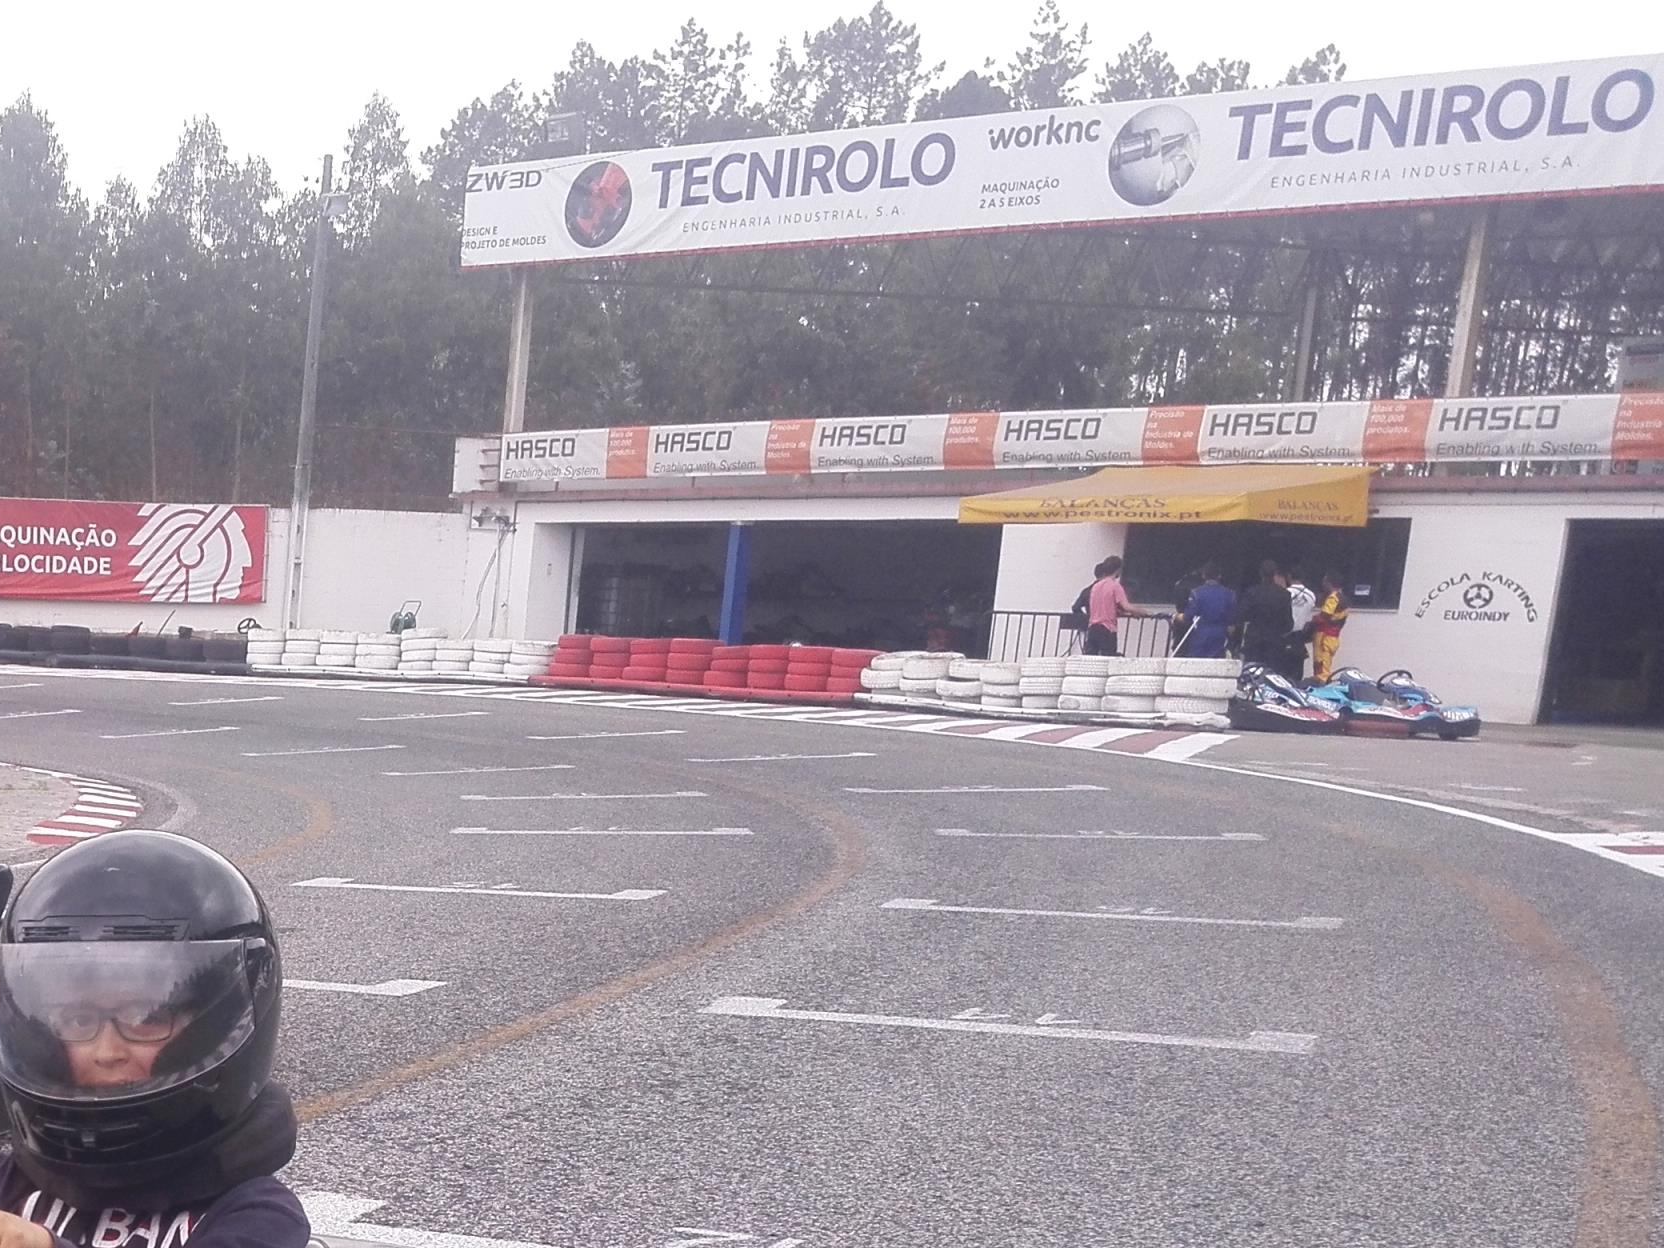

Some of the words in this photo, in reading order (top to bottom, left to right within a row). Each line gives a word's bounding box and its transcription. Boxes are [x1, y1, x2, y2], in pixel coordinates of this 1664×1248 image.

[1228, 68, 1655, 161] TECNIROLO
[988, 114, 1102, 151] worknc
[651, 132, 956, 209] TECNIROLO
[1271, 168, 1391, 189] ENGENHARIA
[1540, 155, 1581, 171] S.A.
[981, 176, 1060, 194] MAQUINAÇÃO
[979, 199, 986, 209] 2
[987, 198, 996, 208] A
[1008, 195, 1041, 207] EIXOS
[493, 226, 499, 236] E
[682, 215, 772, 233] ENGENHARIA
[499, 238, 511, 248] DE
[511, 235, 547, 247] MOLDES
[1209, 412, 1318, 437] HASCO
[1438, 405, 1561, 432] HASCO
[818, 424, 908, 447] HASCO
[1003, 417, 1102, 442] HASCO
[506, 437, 576, 460] HASCO
[654, 430, 733, 453] HASCO
[1437, 442, 1501, 456] Enabling
[1002, 451, 1054, 464] Enabling
[1208, 446, 1265, 460] Enabling
[653, 461, 693, 474] Enabling
[818, 456, 864, 469] Enabling
[504, 468, 544, 480] Enabling
[1414, 572, 1472, 619] ESCOLA
[1481, 571, 1538, 622] KARTING
[1443, 609, 1511, 621] EUROINDY
